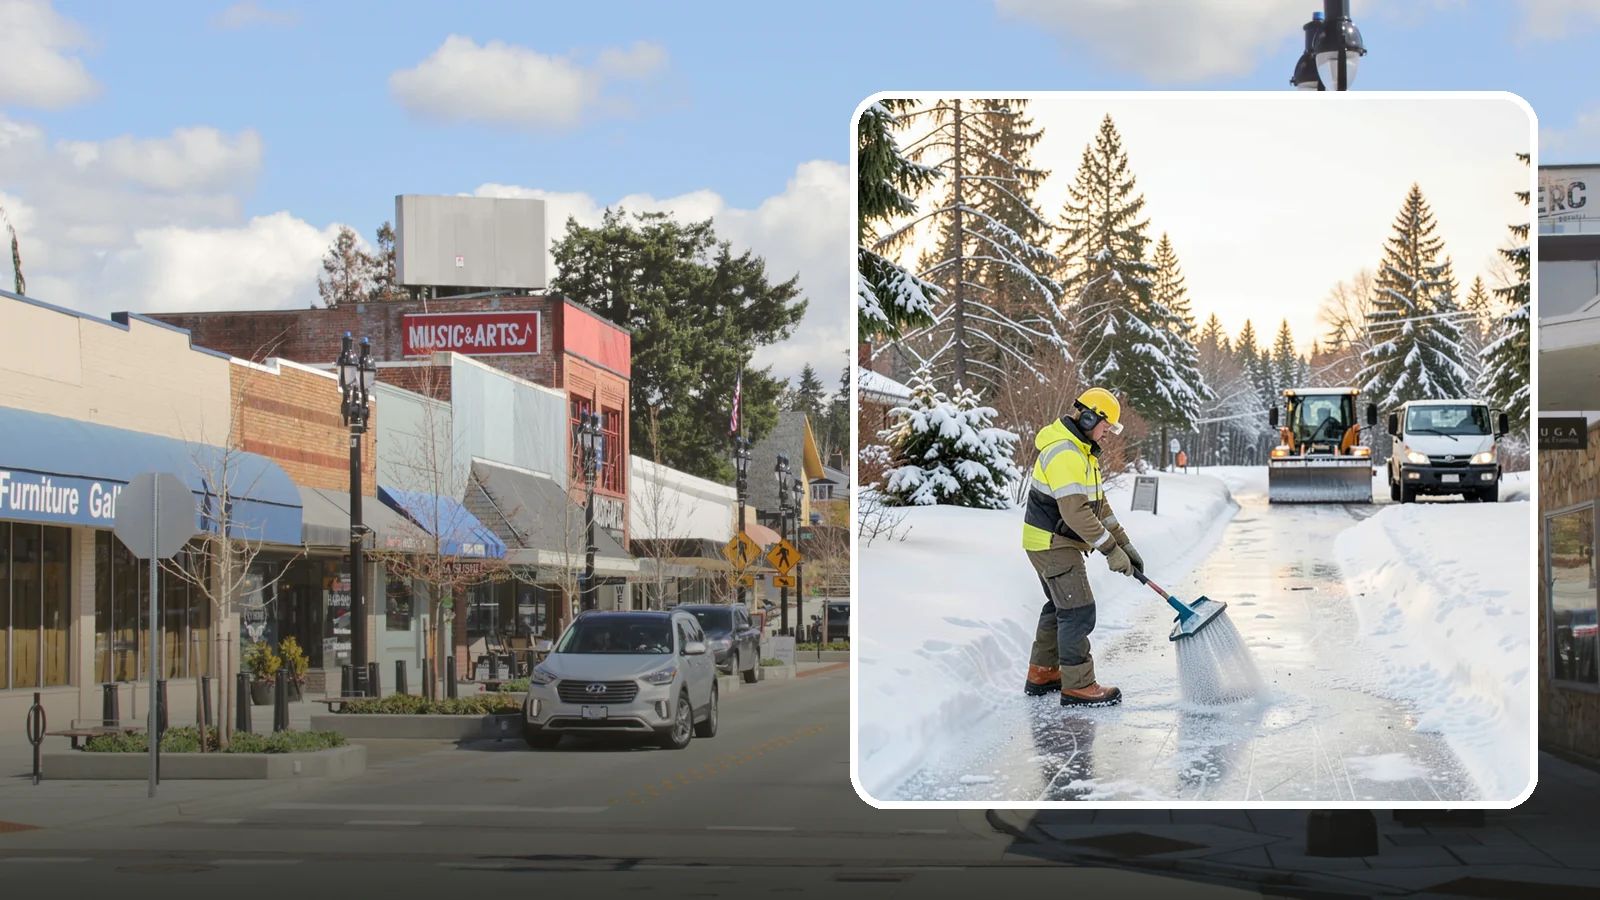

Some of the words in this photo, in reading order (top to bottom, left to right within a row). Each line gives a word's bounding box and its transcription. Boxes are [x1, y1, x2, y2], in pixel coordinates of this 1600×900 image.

[1540, 427, 1578, 437] UGA
[0, 471, 79, 515] Furniture
[89, 482, 122, 519] Gal
[453, 562, 479, 574] SUSHI
